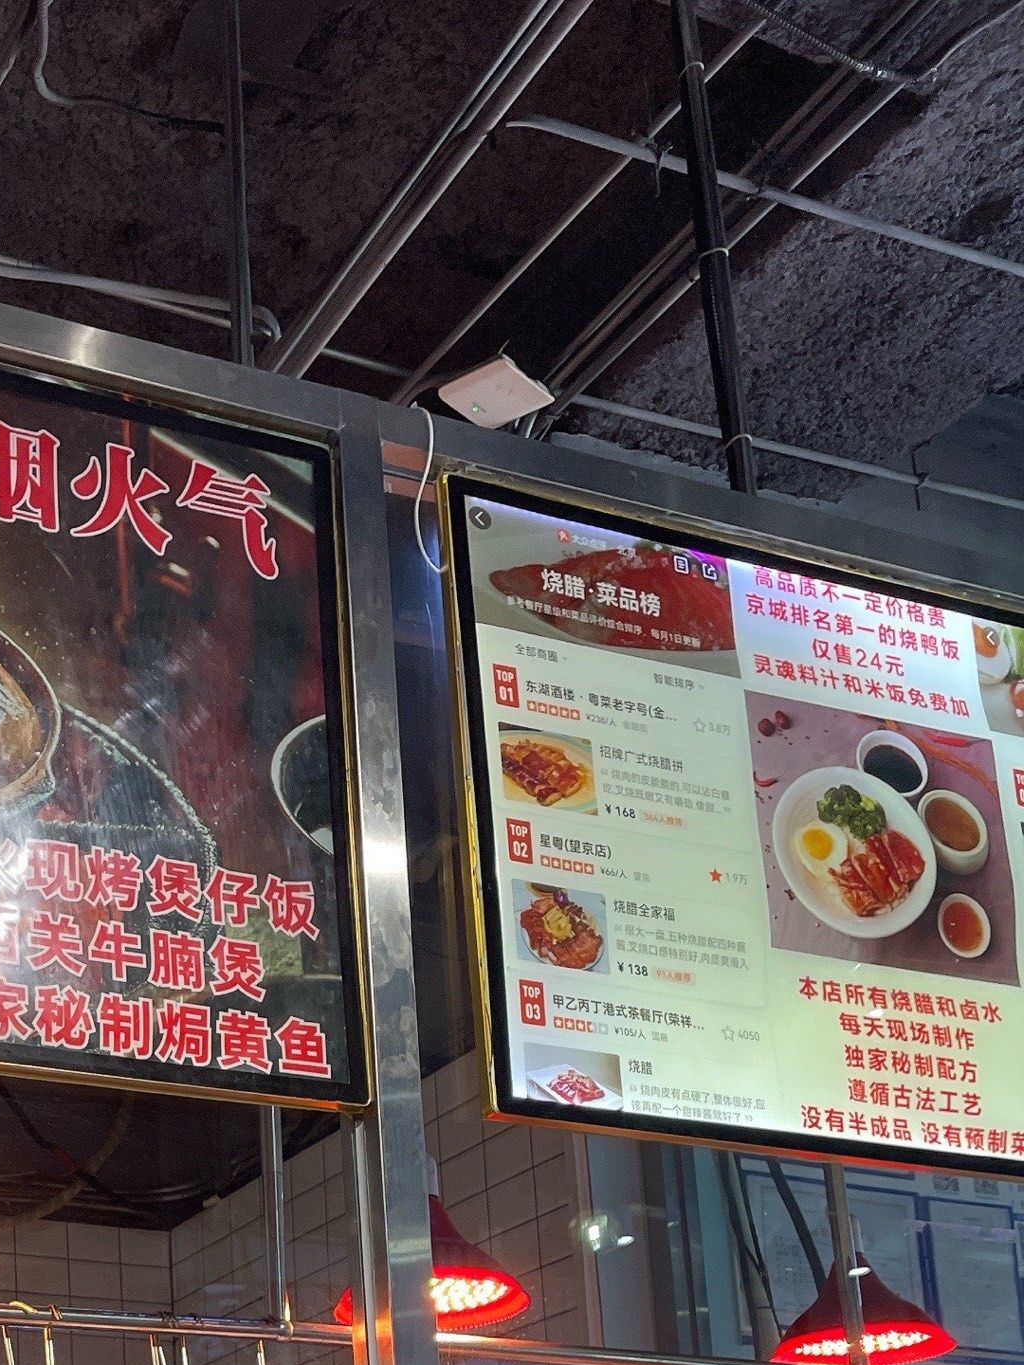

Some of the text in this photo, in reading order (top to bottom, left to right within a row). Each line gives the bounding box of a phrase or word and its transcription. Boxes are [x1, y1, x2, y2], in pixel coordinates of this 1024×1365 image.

[540, 567, 662, 618] 烧腊·菜品榜
[753, 564, 946, 629] 高品质不一定价格贵
[745, 592, 961, 662] 京城排名第一的烧鸭饭
[495, 668, 514, 683] TOP
[812, 637, 905, 677] 仅售24元
[498, 686, 514, 703] 01
[753, 653, 971, 718] 灵魂料汁和米饭免费加
[509, 823, 528, 837] TOP
[539, 832, 612, 859] 星粤(望京店)
[512, 842, 528, 859] 02
[613, 898, 676, 922] 烧腊全家福
[522, 984, 541, 999] TOP
[798, 975, 1003, 1024] 本店所有烧腊和卤水
[525, 1003, 541, 1021] 03
[838, 1012, 976, 1051] 每天现场制作
[628, 1058, 653, 1076] 烧腊
[844, 1044, 978, 1084] 独家秘制配方
[847, 1077, 983, 1118] 遵循古法工艺
[800, 1104, 1024, 1156] 没有半成品 没有预制菜
